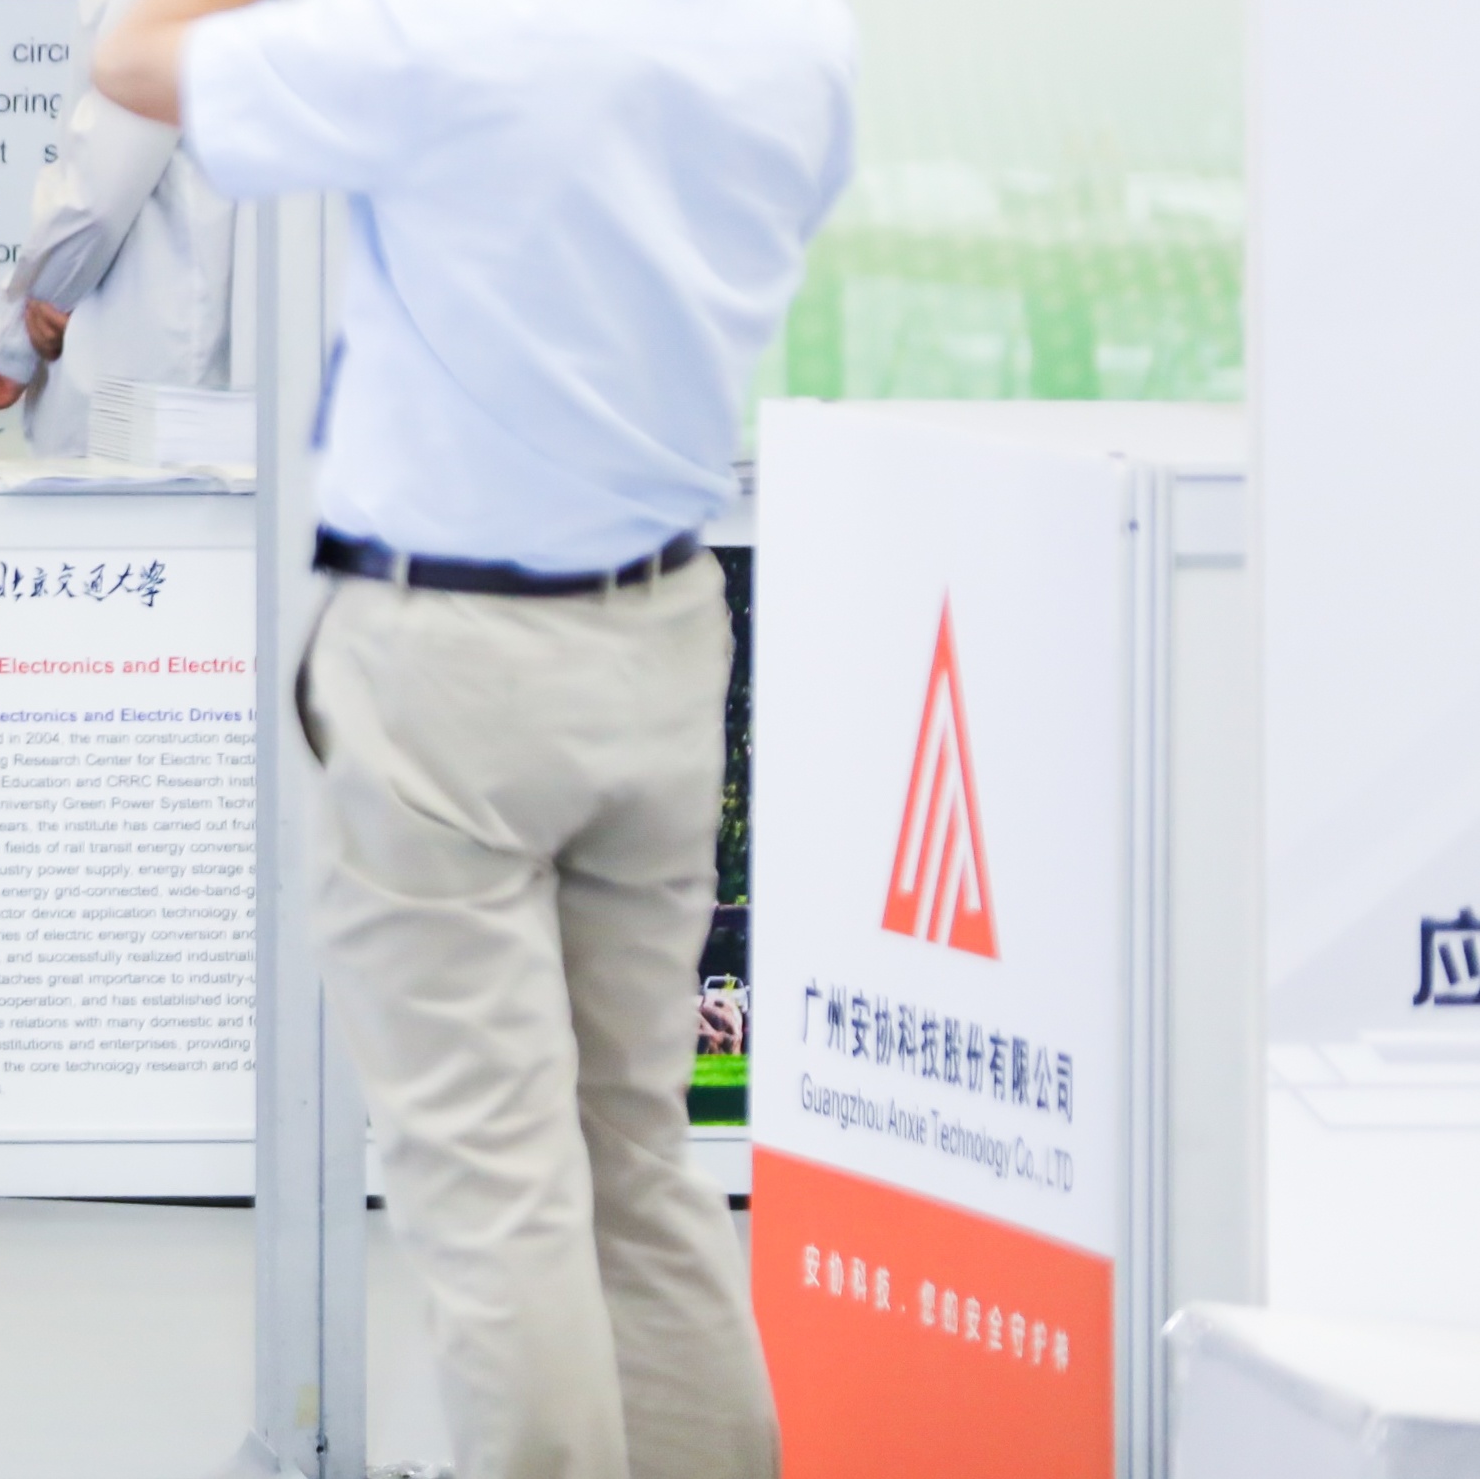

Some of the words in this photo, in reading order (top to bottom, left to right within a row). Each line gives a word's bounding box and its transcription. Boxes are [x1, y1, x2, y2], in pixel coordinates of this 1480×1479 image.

[123, 655, 162, 676] and
[168, 654, 248, 675] Electric
[83, 707, 116, 724] and
[120, 707, 185, 724] Electric
[189, 707, 245, 724] Drives
[9, 732, 22, 745] in
[25, 731, 65, 747] 2004,
[69, 731, 92, 745] the
[97, 731, 132, 745] main
[135, 731, 221, 745] construction
[800, 977, 1074, 1125] 广州安协科技股份有限公司
[800, 1071, 885, 1132] Guangzhou
[887, 1097, 928, 1146] Anxie
[931, 1108, 1013, 1180] Technology
